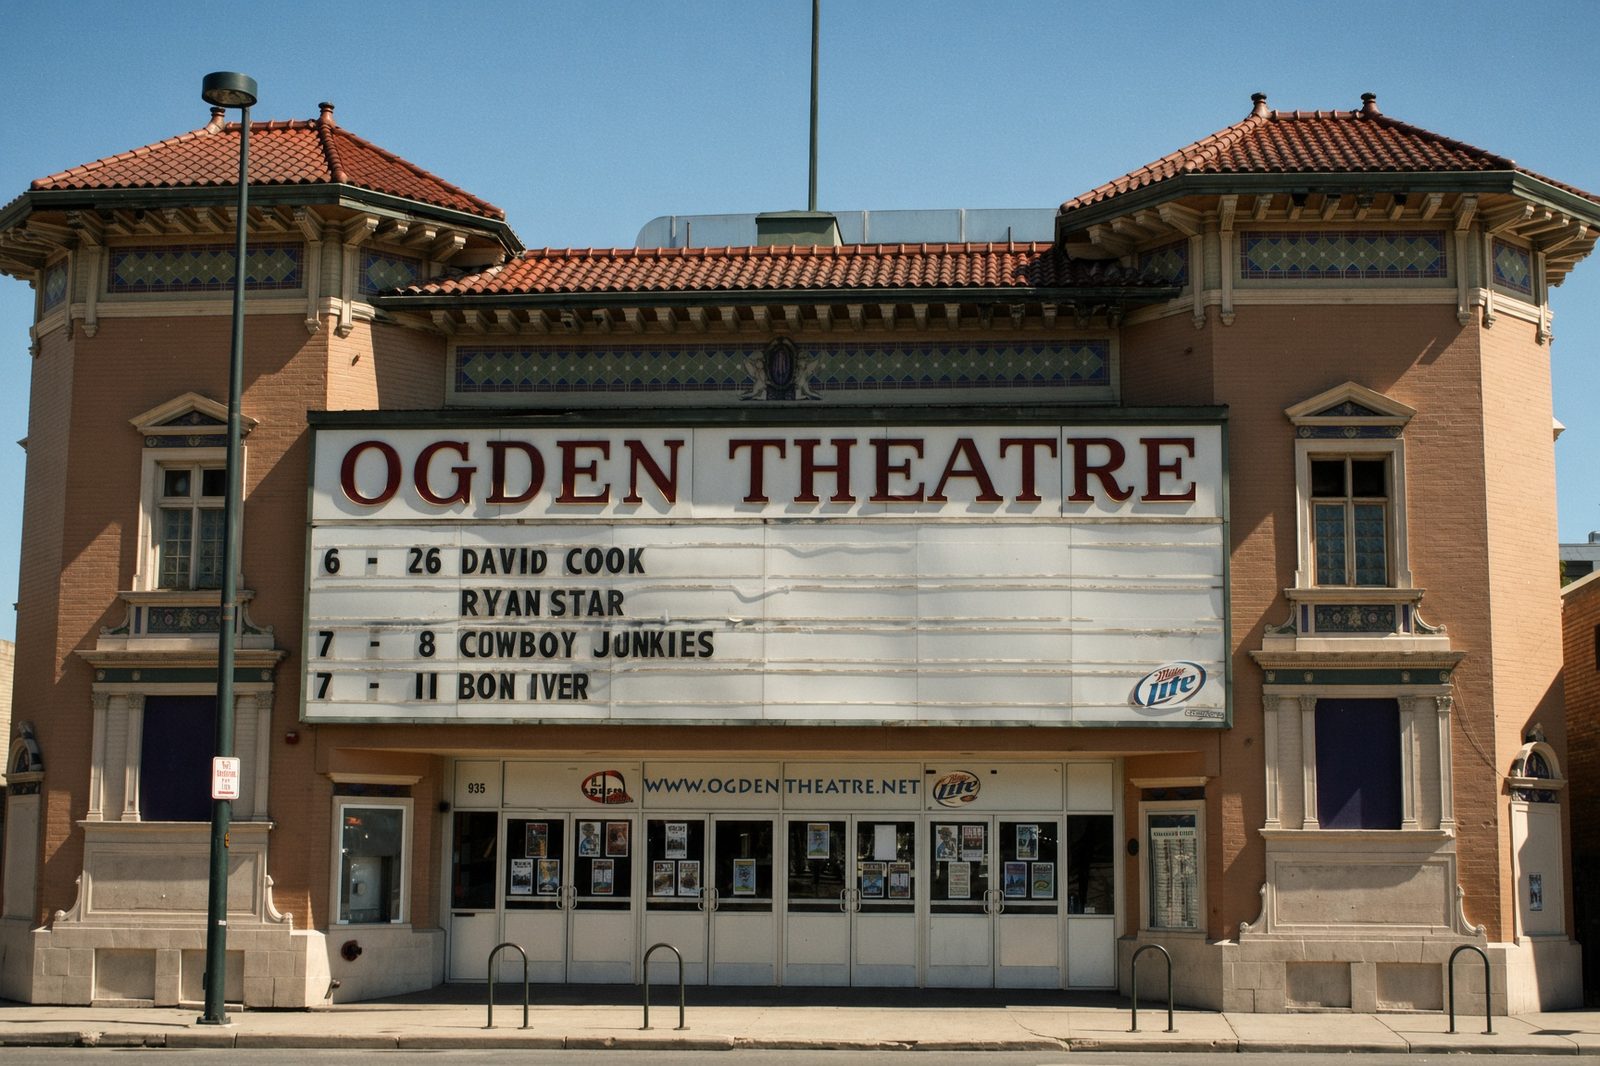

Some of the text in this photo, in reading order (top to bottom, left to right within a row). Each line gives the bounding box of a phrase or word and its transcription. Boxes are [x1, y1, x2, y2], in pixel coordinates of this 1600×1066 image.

[340, 437, 1197, 505] OGDEN THEATRE
[325, 548, 340, 574] 6
[409, 548, 441, 574] 26
[462, 548, 547, 574] DAVID
[566, 548, 644, 575] COOK
[462, 589, 623, 616] RYAN STAR
[319, 631, 334, 657] 7
[419, 631, 435, 657] 8
[460, 631, 576, 658] COWBOY
[594, 631, 713, 658] JUNKIES
[317, 672, 332, 698] 7
[459, 673, 515, 699] BON
[531, 673, 588, 699] IVER
[1147, 675, 1196, 707] Lite
[467, 782, 486, 794] 935
[937, 780, 978, 801] Lite
